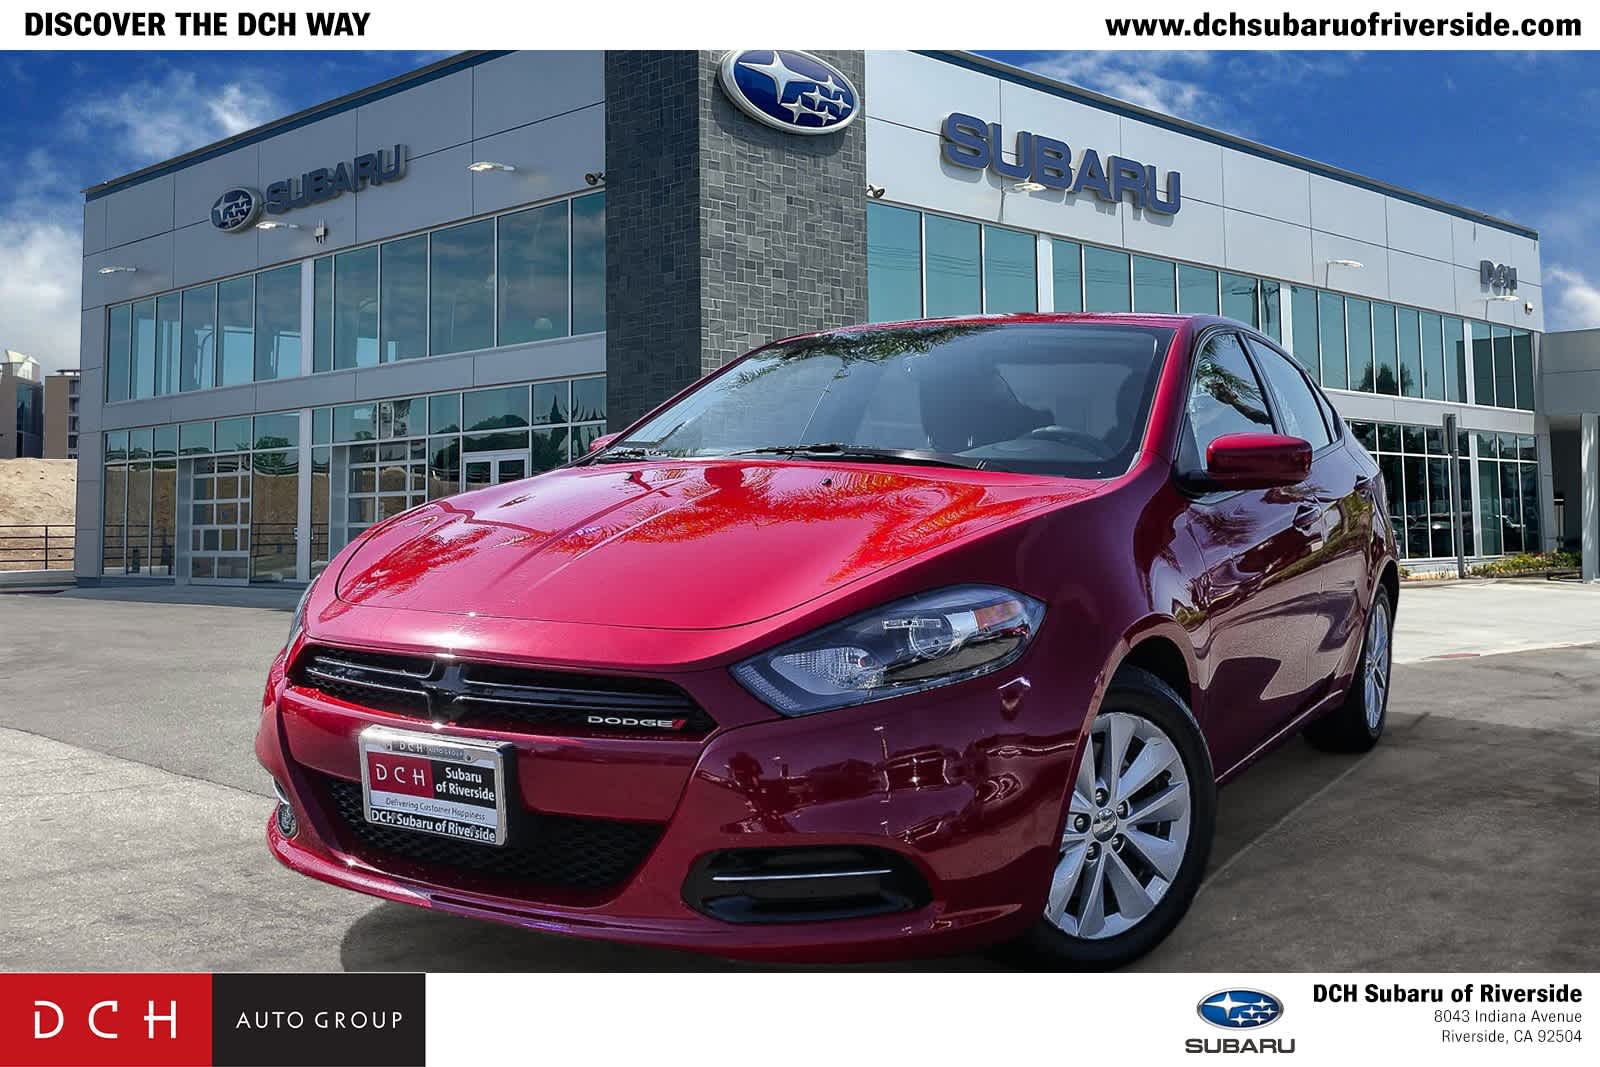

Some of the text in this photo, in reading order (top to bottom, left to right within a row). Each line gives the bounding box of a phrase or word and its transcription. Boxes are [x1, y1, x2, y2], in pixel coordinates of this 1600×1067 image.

[942, 112, 1181, 215] SUBARU
[265, 143, 406, 215] SUBARU
[587, 715, 673, 728] DODGE
[375, 763, 425, 787] DCH
[445, 767, 482, 783] Subaru
[436, 781, 495, 801] of Riverside
[386, 797, 486, 821] Delivering Customer Happiness
[371, 809, 496, 843] DCH Subaru of Riverside
